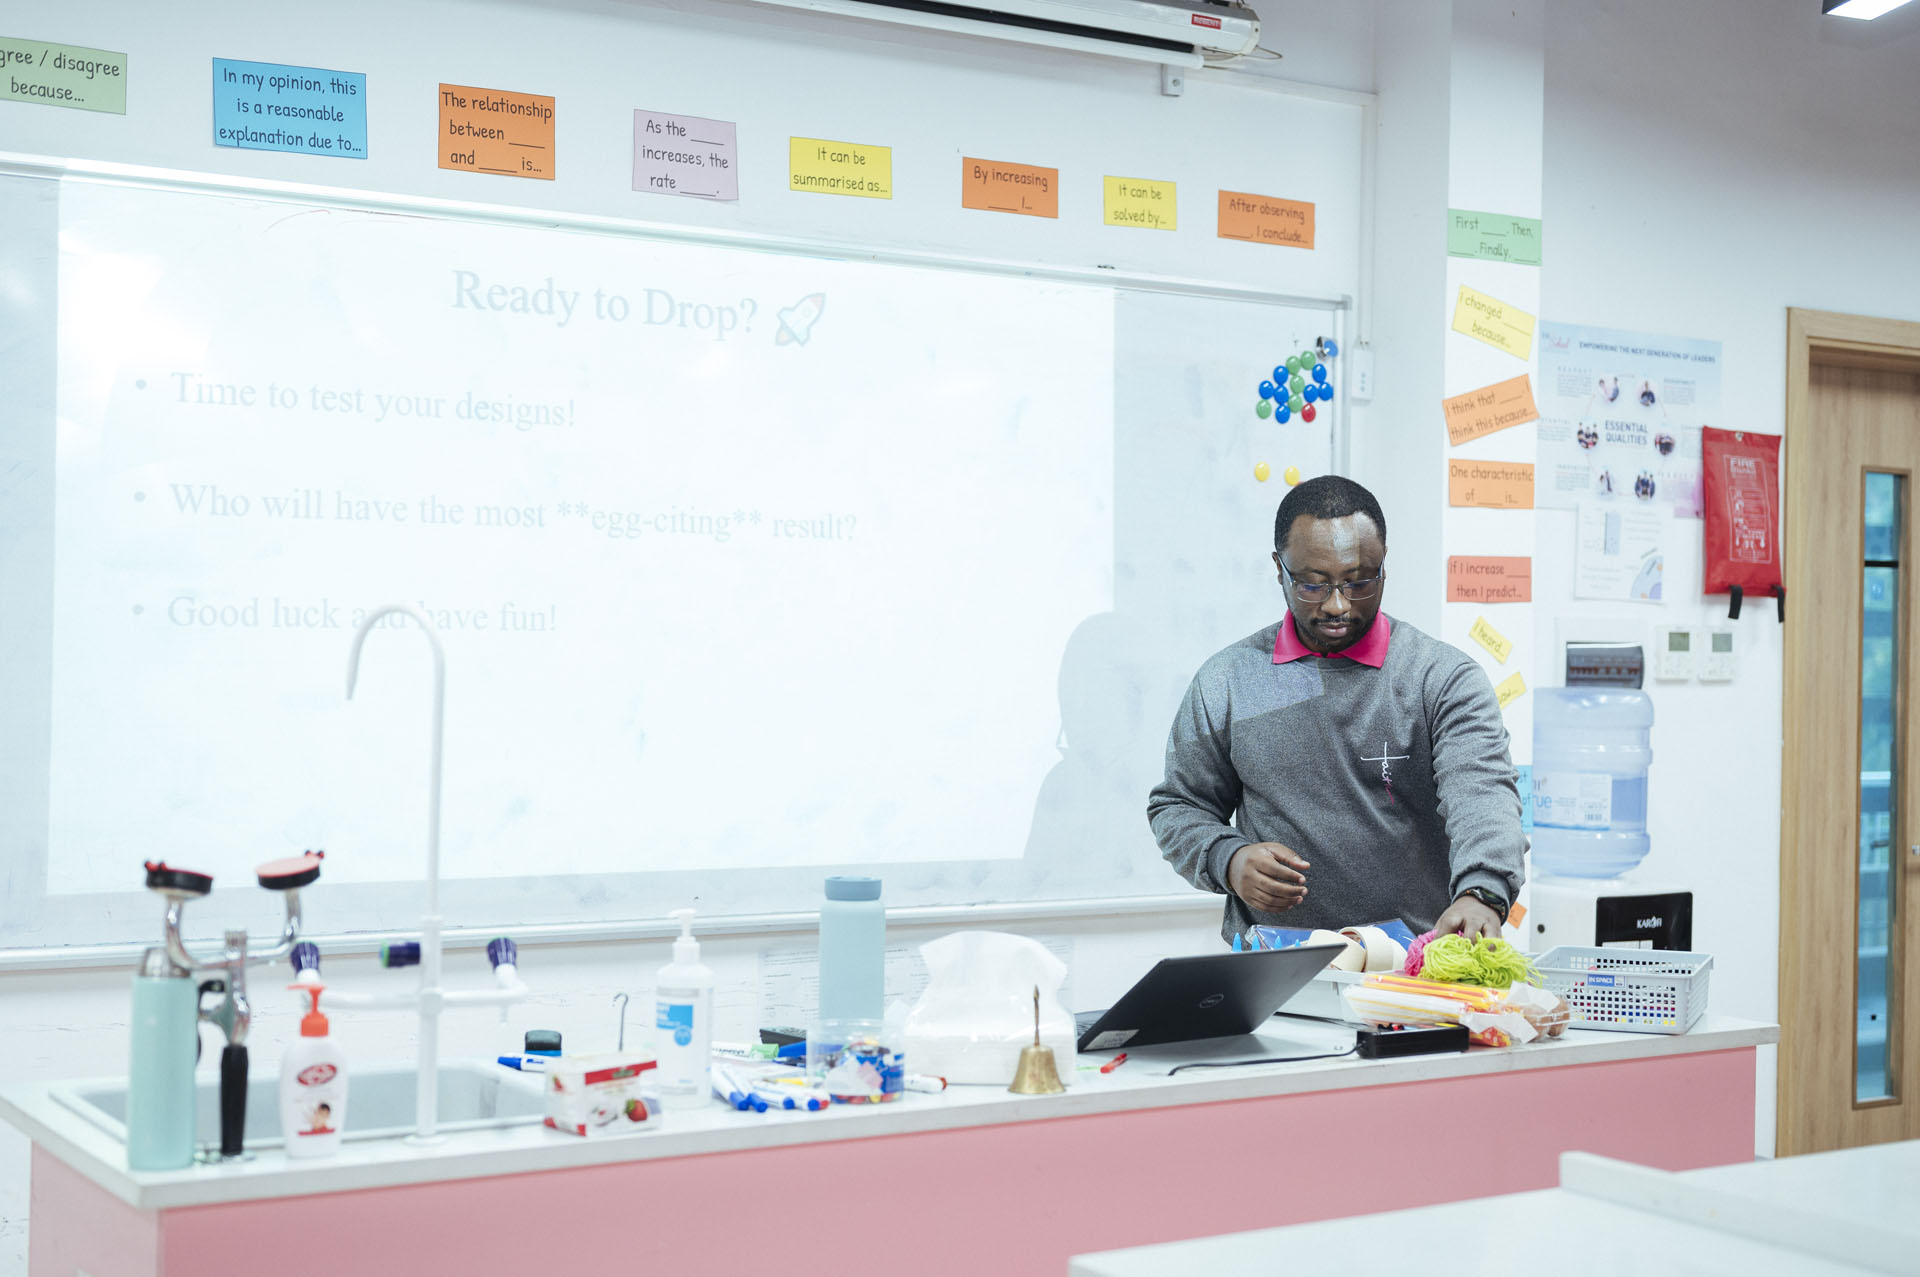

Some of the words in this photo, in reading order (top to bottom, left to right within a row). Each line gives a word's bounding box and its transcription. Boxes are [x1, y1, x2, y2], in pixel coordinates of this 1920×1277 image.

[53, 52, 120, 80] disagree
[11, 75, 85, 102] because...
[223, 67, 237, 83] In
[242, 73, 264, 92] my
[269, 74, 325, 94] opinion,
[330, 77, 357, 95] this
[237, 98, 249, 112] is
[253, 103, 262, 114] a
[267, 104, 344, 122] reasonable
[441, 91, 467, 108] The
[472, 95, 552, 125] relationship
[219, 126, 304, 147] explanation
[308, 131, 333, 149] due
[337, 134, 362, 152] to...
[449, 118, 504, 140] between
[646, 119, 662, 134] As
[666, 120, 687, 137] the
[450, 149, 475, 165] and
[521, 156, 542, 173] is...
[642, 144, 705, 167] increases,
[709, 152, 729, 169] the
[817, 146, 827, 160] It
[830, 151, 850, 163] can
[853, 150, 866, 165] be
[650, 173, 676, 189] rate
[793, 174, 864, 191] summarised
[974, 165, 988, 184] By
[992, 168, 1048, 192] increasing
[1119, 183, 1127, 197] It
[1130, 187, 1147, 199] can
[1150, 185, 1162, 200] be
[1113, 207, 1145, 223] solved
[1229, 198, 1257, 213] After
[1259, 202, 1305, 225] observing
[1455, 215, 1480, 230] First
[450, 269, 580, 329] Ready
[593, 287, 631, 323] to
[642, 287, 758, 342] Drop?
[1465, 295, 1503, 320] changed
[170, 371, 256, 407] Time
[268, 382, 299, 409] to
[309, 383, 365, 415] test
[375, 393, 446, 423] your
[455, 391, 576, 432] designs!
[1451, 399, 1475, 416] think
[1477, 390, 1496, 406] that
[1451, 423, 1474, 440] think
[1475, 417, 1494, 432] this
[1605, 420, 1648, 433] ESSENTIAL
[1605, 433, 1648, 446] QUALITIES
[1451, 464, 1468, 478] One
[1470, 465, 1533, 482] characteristic
[1465, 488, 1475, 502] of
[170, 482, 250, 518] Who
[262, 487, 325, 520] will
[335, 489, 409, 522] have
[419, 494, 465, 525] the
[474, 500, 547, 528] most
[773, 512, 858, 541] result?
[1449, 560, 1457, 574] If
[1466, 562, 1505, 575] increase
[1456, 584, 1478, 598] then
[166, 595, 261, 630] Good
[271, 596, 340, 630] luck
[498, 601, 558, 632] fun!
